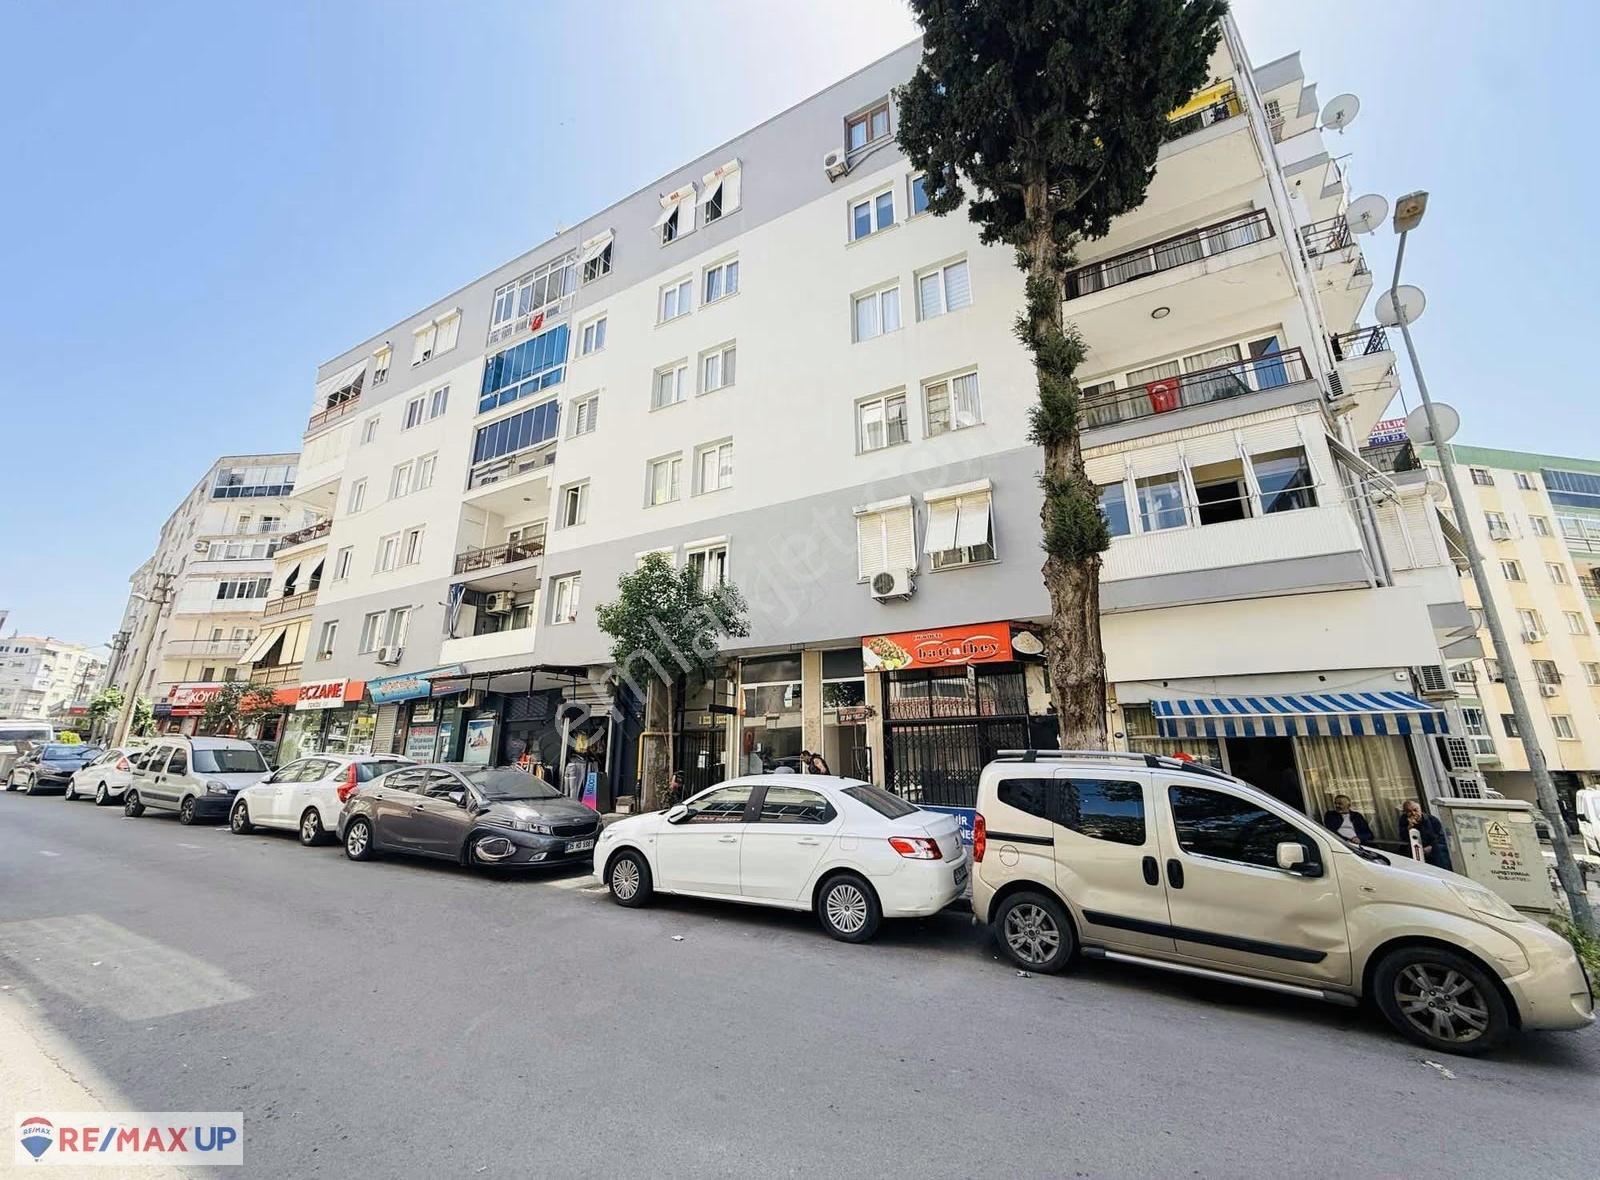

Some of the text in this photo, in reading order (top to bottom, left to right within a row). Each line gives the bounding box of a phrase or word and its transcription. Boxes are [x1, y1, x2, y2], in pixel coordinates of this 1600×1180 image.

[1373, 419, 1405, 431] ATILIK
[917, 639, 999, 659] battalbey
[299, 683, 343, 700] ECZANE
